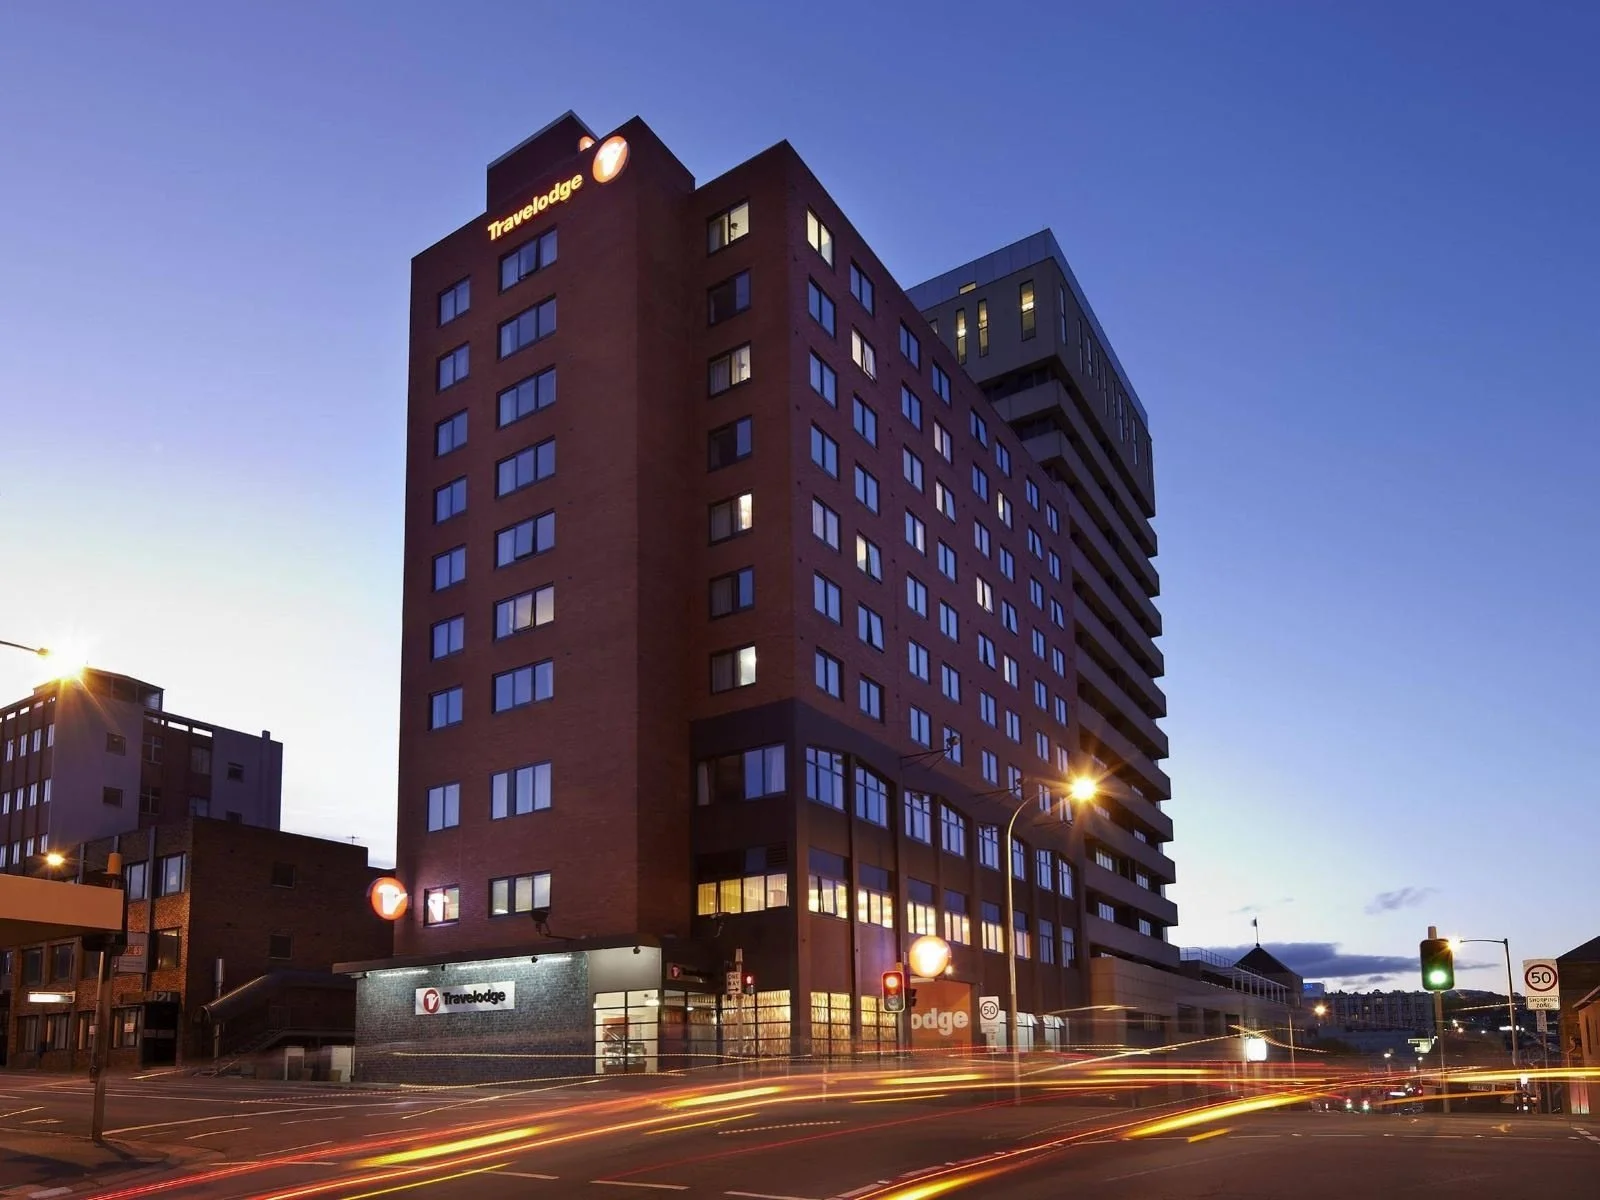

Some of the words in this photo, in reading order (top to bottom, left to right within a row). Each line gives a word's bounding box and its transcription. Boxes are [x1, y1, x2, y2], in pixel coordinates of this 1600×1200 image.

[487, 174, 583, 241] Travelodge
[1531, 972, 1552, 984] 50
[442, 989, 506, 1005] Travelodge
[983, 1006, 996, 1015] 50
